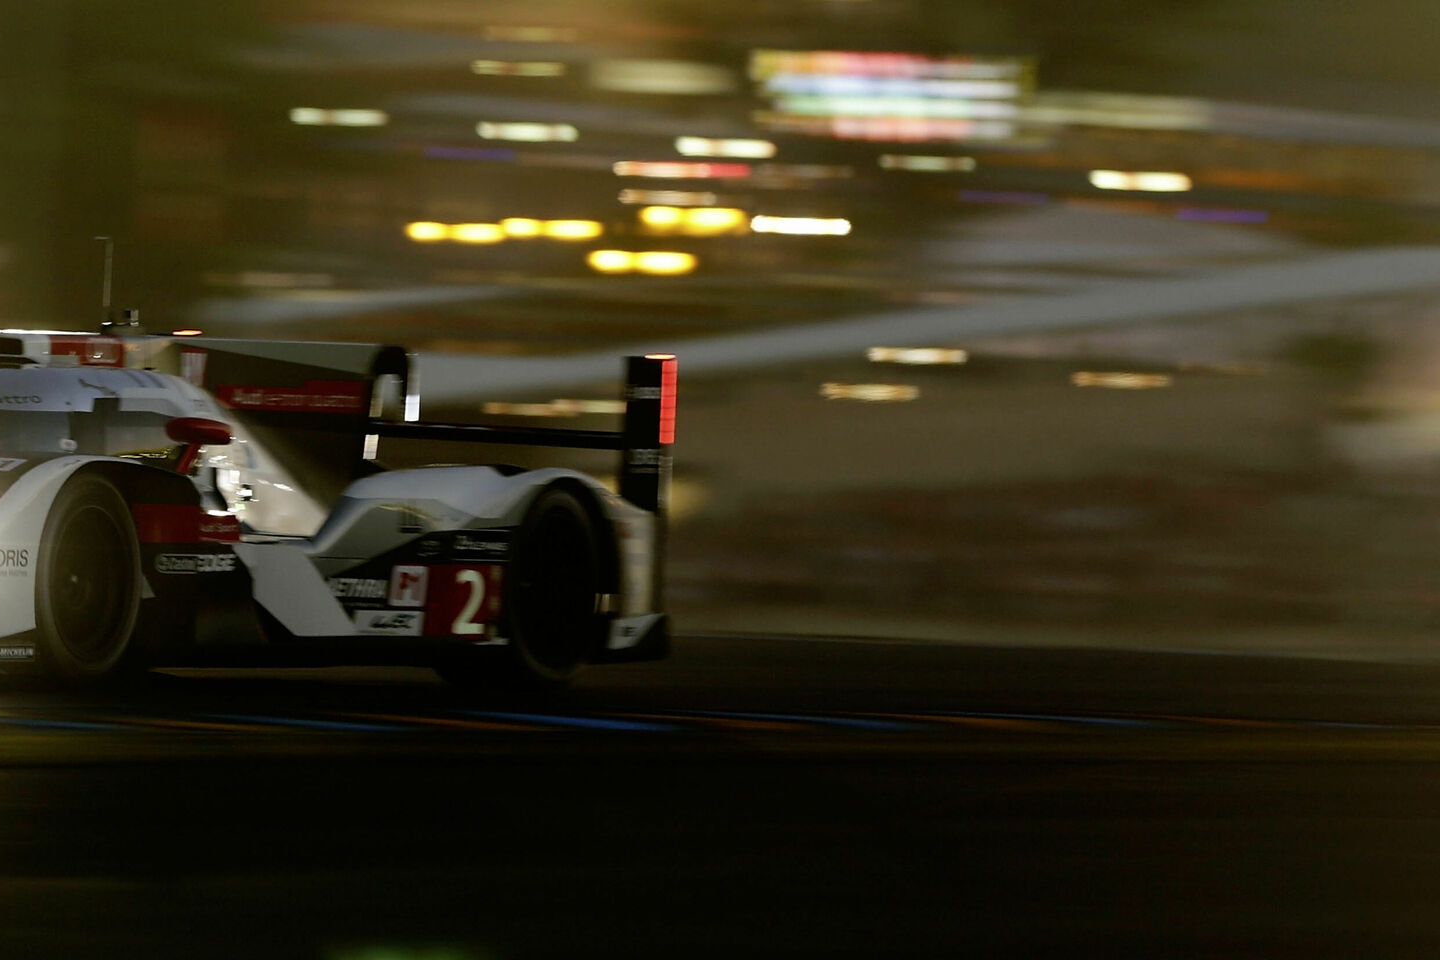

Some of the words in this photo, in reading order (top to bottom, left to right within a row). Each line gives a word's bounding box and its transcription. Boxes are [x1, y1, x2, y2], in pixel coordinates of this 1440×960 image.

[197, 554, 237, 572] EDGE
[452, 569, 486, 635] 2
[0, 647, 34, 657] MICHELIN
